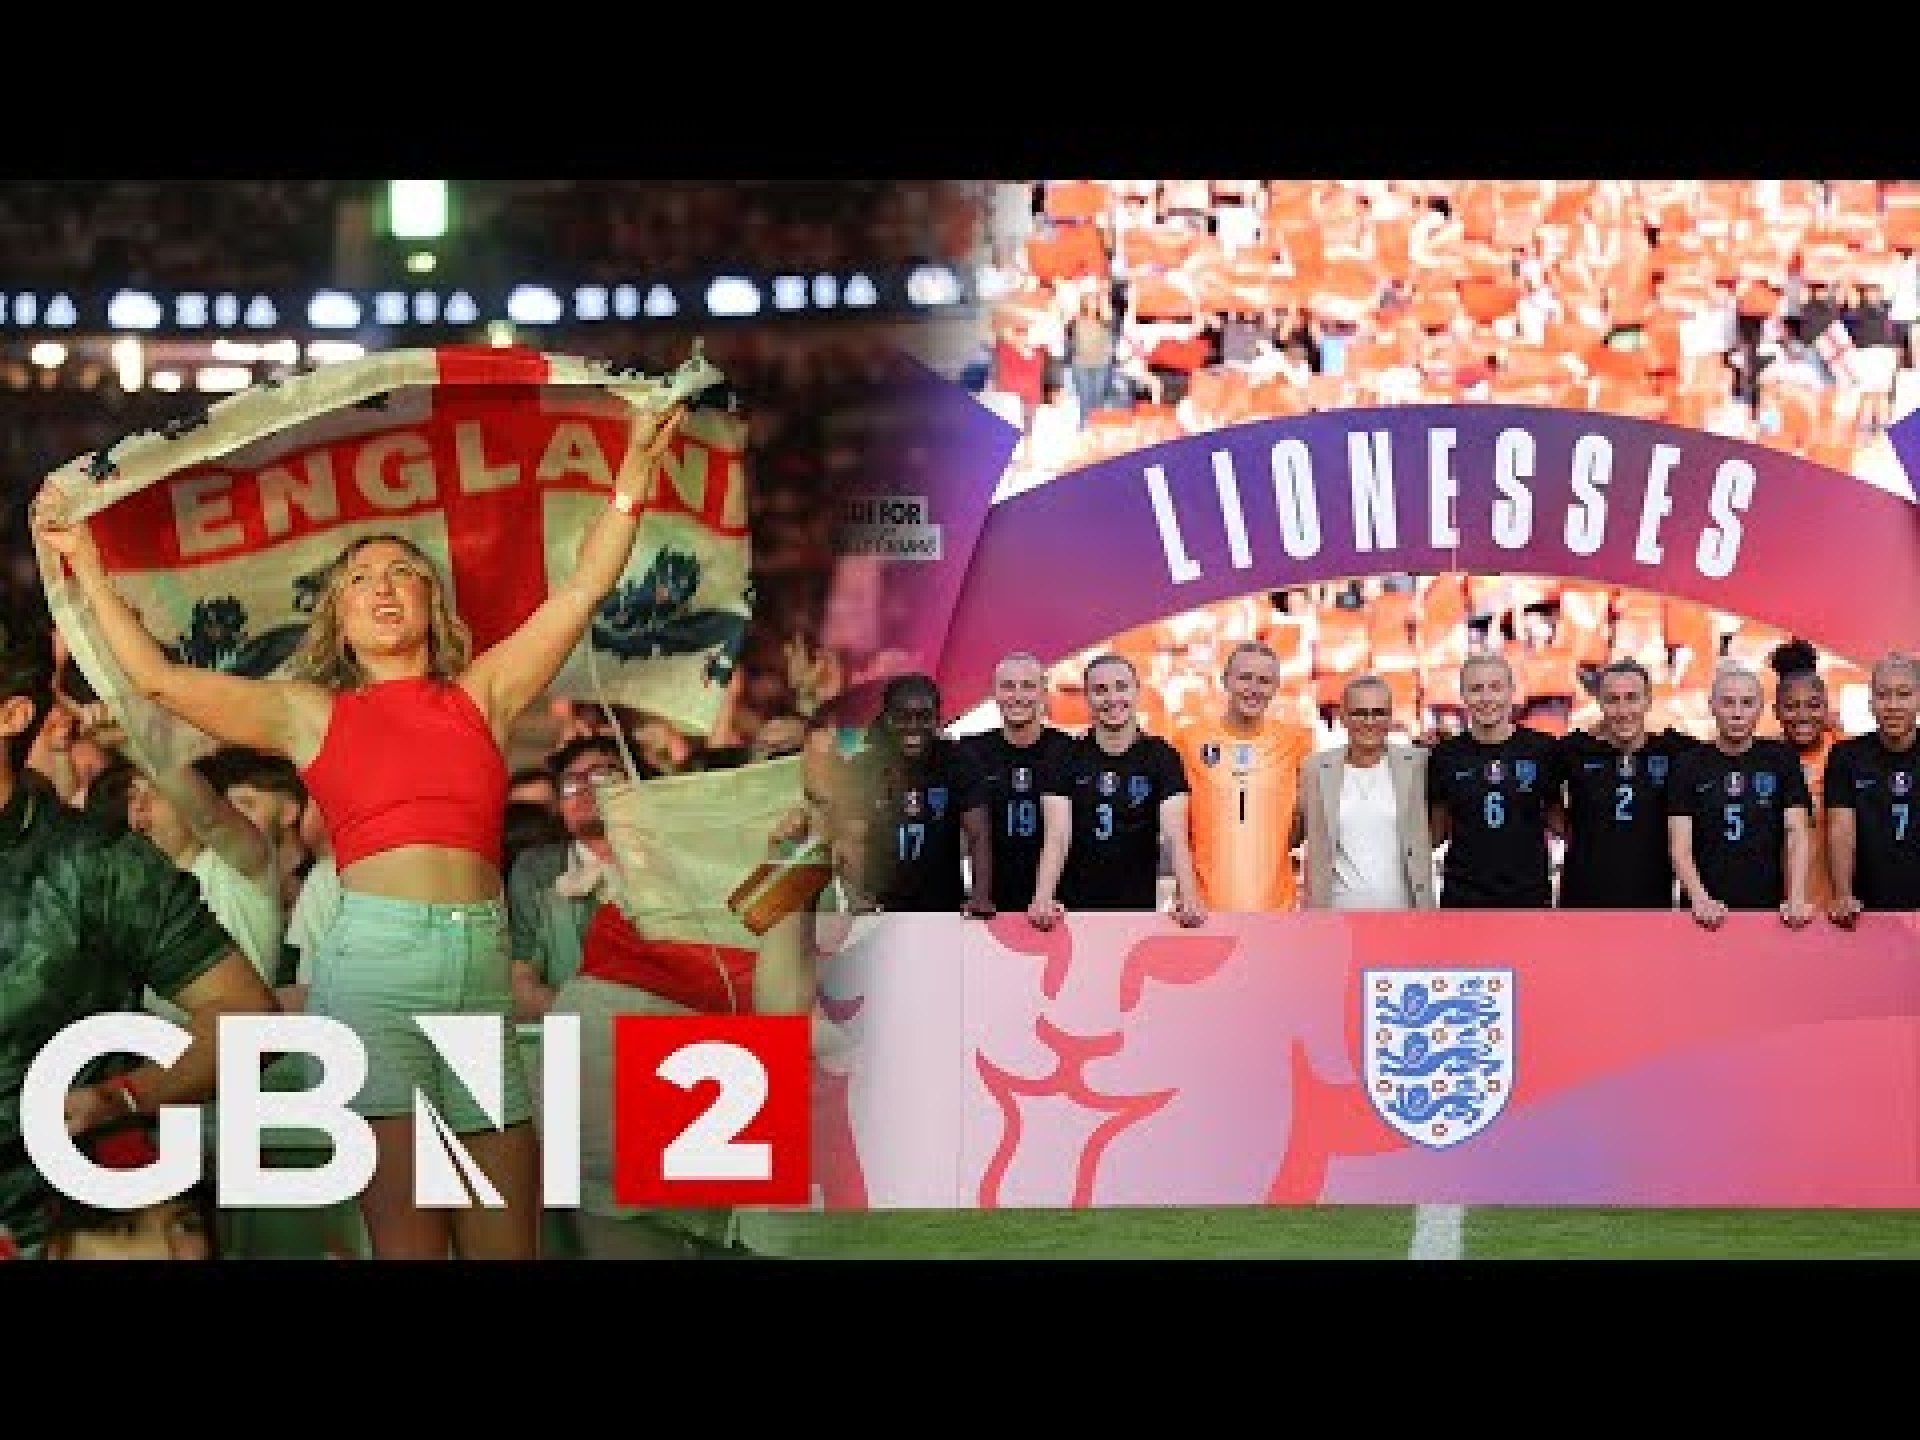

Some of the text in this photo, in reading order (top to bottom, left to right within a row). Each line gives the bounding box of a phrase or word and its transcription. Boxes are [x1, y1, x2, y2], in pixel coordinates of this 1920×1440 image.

[1143, 427, 1758, 585] LIONESSES
[1007, 799, 1036, 837] 19
[1483, 791, 1505, 828] 6
[1615, 784, 1634, 820] 2
[1094, 803, 1113, 840] 3
[1723, 803, 1744, 841] 5
[1891, 803, 1909, 841] 7
[898, 822, 925, 860] 17
